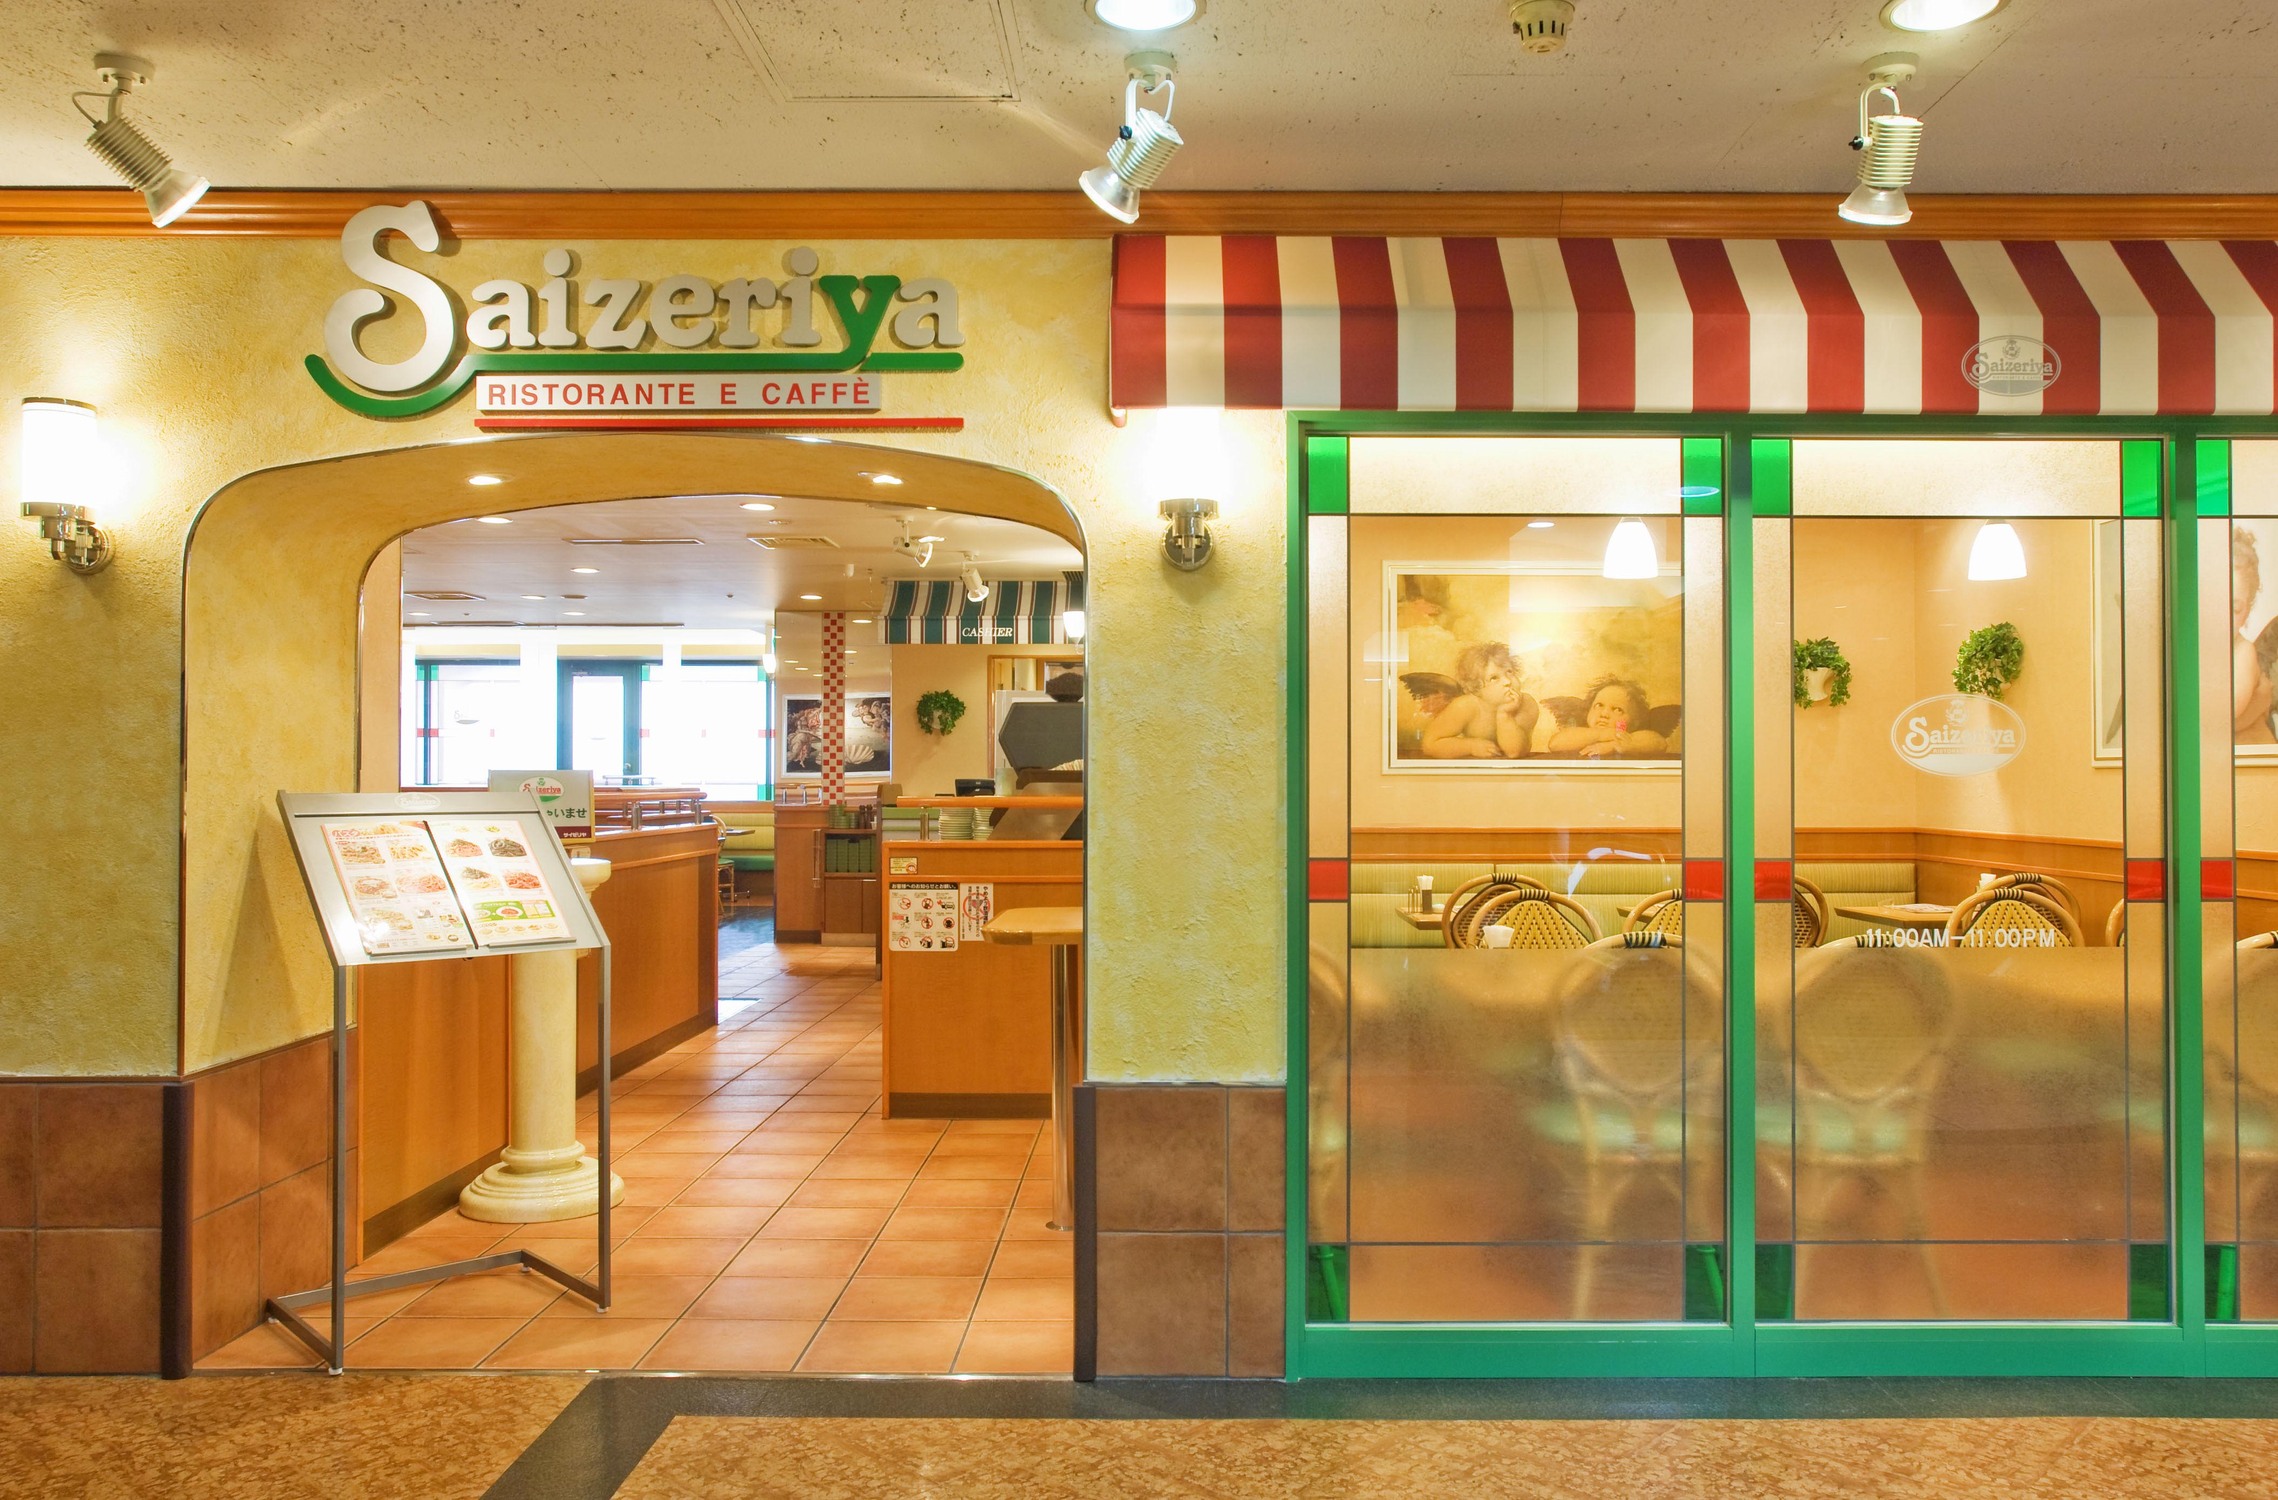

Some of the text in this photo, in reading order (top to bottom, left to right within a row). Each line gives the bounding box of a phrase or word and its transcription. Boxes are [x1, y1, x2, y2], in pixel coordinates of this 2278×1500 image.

[323, 199, 966, 394] Saizeriya
[1971, 352, 2054, 377] Saizeriya
[487, 376, 871, 406] RISTORANTE E CAFFÈ
[962, 627, 1013, 637] CASHIER
